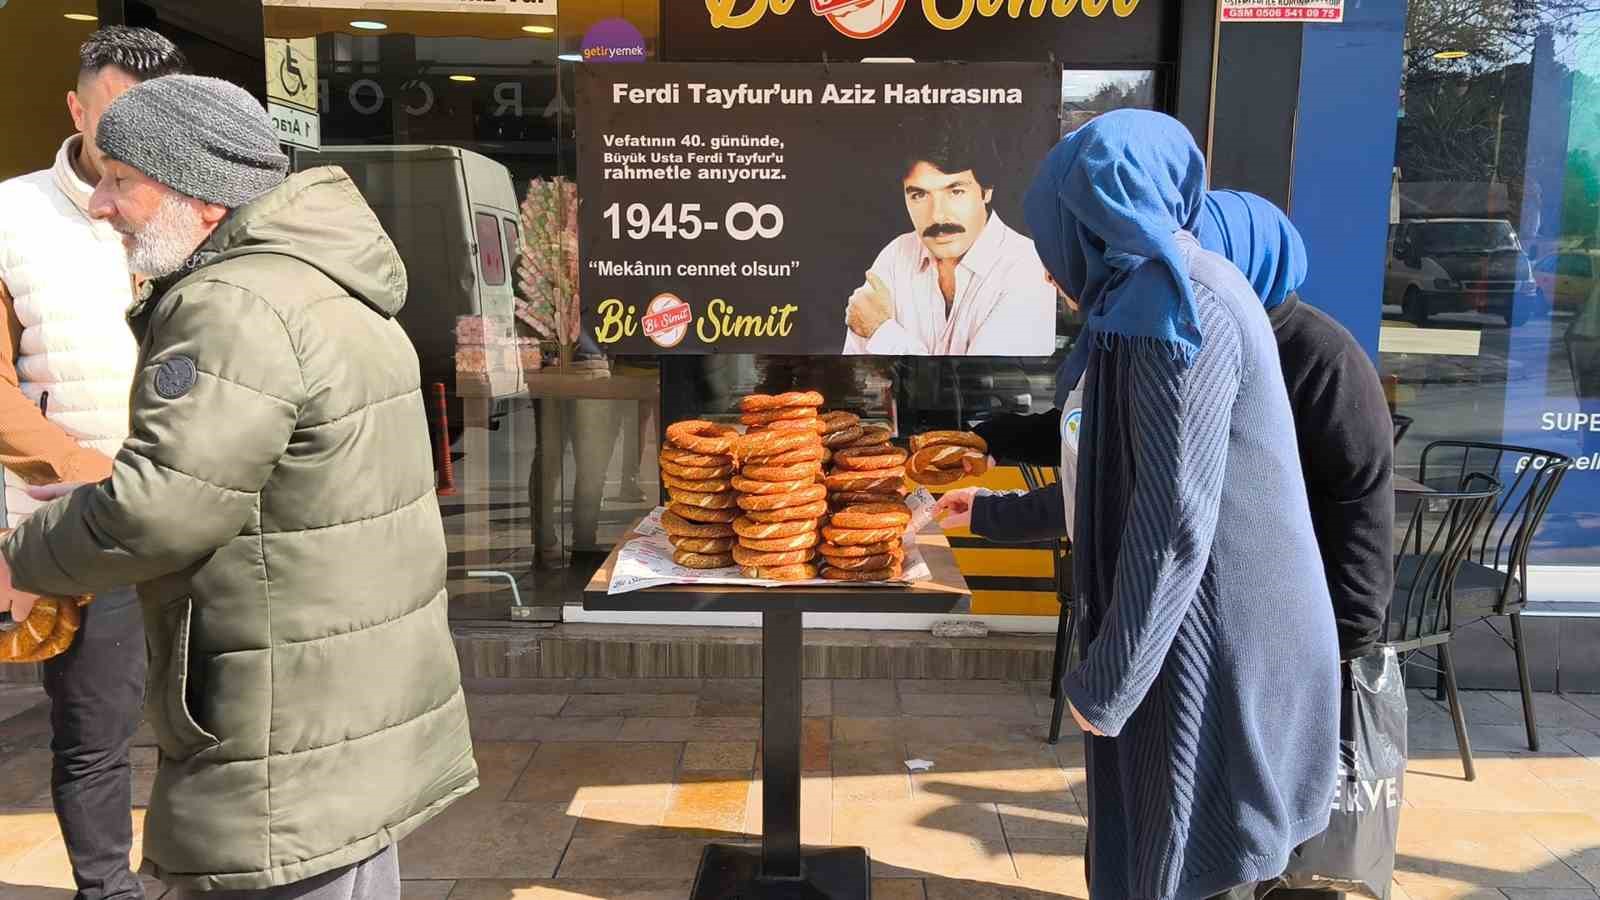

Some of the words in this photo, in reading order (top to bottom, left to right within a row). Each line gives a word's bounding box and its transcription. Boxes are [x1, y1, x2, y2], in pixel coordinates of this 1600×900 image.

[1230, 8, 1254, 17] GSM
[1306, 8, 1319, 17] 09
[1321, 8, 1335, 18] 75
[584, 45, 643, 58] getiryemek
[612, 83, 680, 104] Ferdi
[687, 83, 813, 110] Tayfur’un
[820, 83, 876, 104] Aziz
[883, 83, 1023, 104] Hatırasına
[603, 134, 676, 147] Vefatının
[681, 134, 706, 147] 40.
[710, 134, 785, 150] gününde,
[603, 152, 647, 165] Büyük
[651, 152, 683, 163] Usta
[687, 152, 723, 163] Ferdi
[726, 152, 784, 165] Tayfur'u
[603, 165, 692, 180] rahmetle
[697, 167, 787, 183] anıyoruz.
[677, 261, 737, 277] cennet
[594, 298, 638, 344] Bi
[696, 298, 799, 344] Simit
[1540, 411, 1600, 432] SUPE
